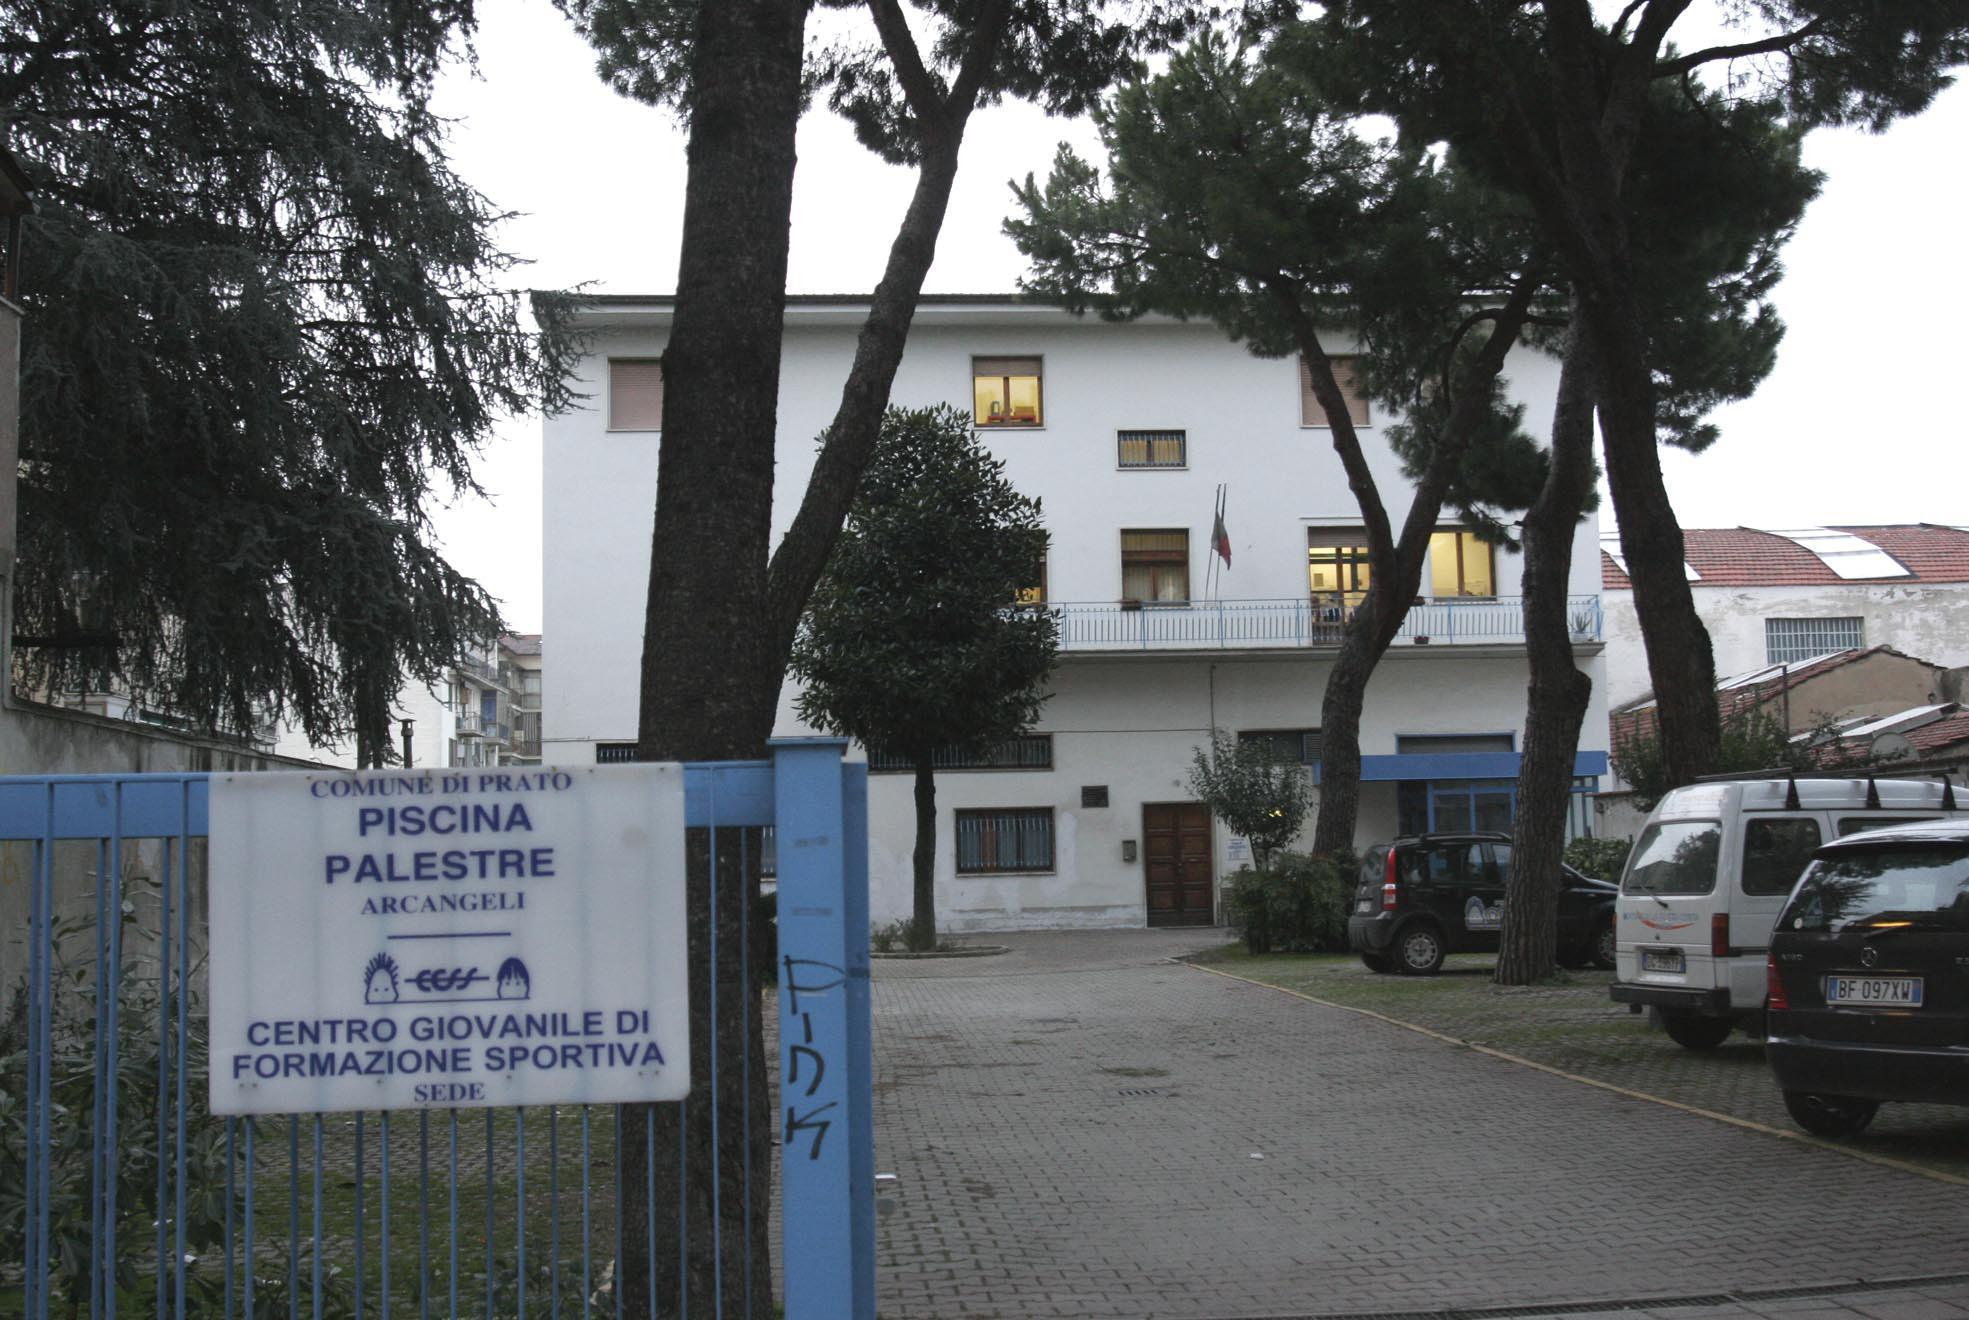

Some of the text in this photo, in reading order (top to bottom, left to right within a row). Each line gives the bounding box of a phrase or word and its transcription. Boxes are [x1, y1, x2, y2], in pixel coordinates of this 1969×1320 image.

[310, 772, 572, 798] COMUNE DI PRATO
[359, 803, 533, 837] PISCINA
[325, 848, 555, 884] PALESTRE
[361, 892, 526, 915] ARCANGELI
[1838, 980, 1857, 998] BF
[246, 1010, 649, 1047] CENTRO GIOVANILE DI
[233, 1041, 665, 1079] FORMAZIONE SPORTIVA
[414, 1083, 485, 1102] SEDE
